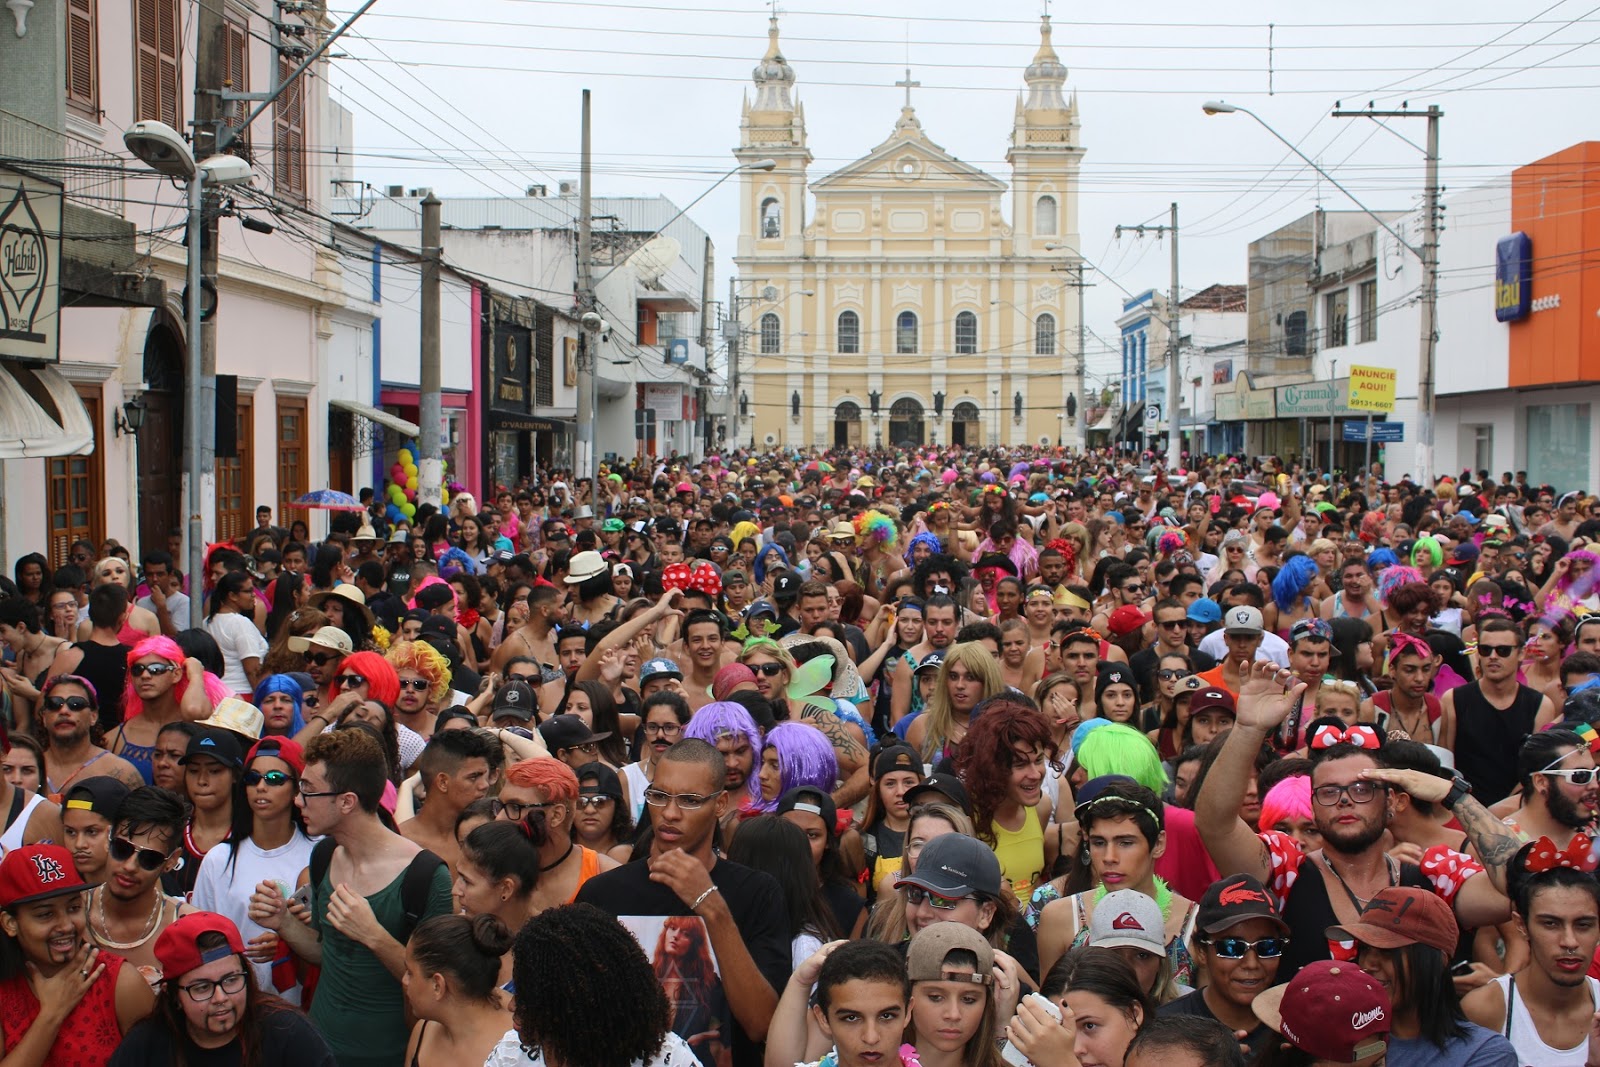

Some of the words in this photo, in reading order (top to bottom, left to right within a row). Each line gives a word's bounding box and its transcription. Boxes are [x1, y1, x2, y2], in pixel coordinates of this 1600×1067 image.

[5, 239, 37, 278] Habib
[1351, 368, 1396, 381] ANUNCIE
[1359, 382, 1387, 391] AQUI!
[31, 853, 66, 884] LA
[1351, 1005, 1385, 1030] Chronic
